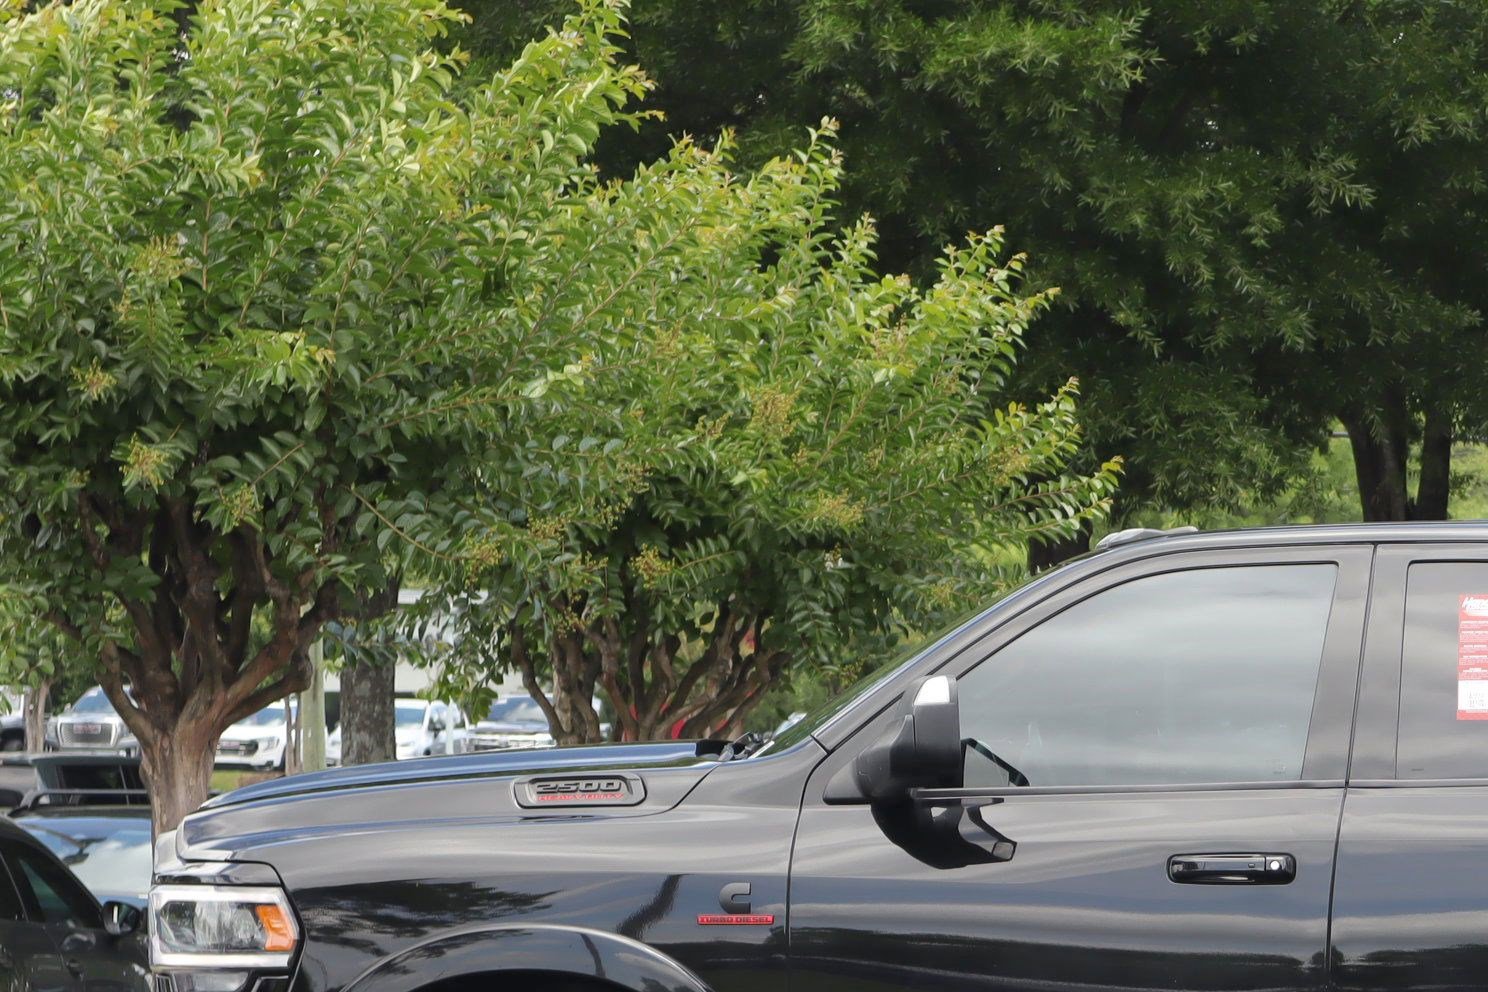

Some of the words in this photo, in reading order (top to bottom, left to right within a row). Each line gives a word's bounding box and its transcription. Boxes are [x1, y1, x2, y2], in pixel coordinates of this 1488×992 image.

[536, 781, 622, 794] 2500
[700, 916, 733, 924] TURBO
[736, 916, 772, 924] DIESEL
